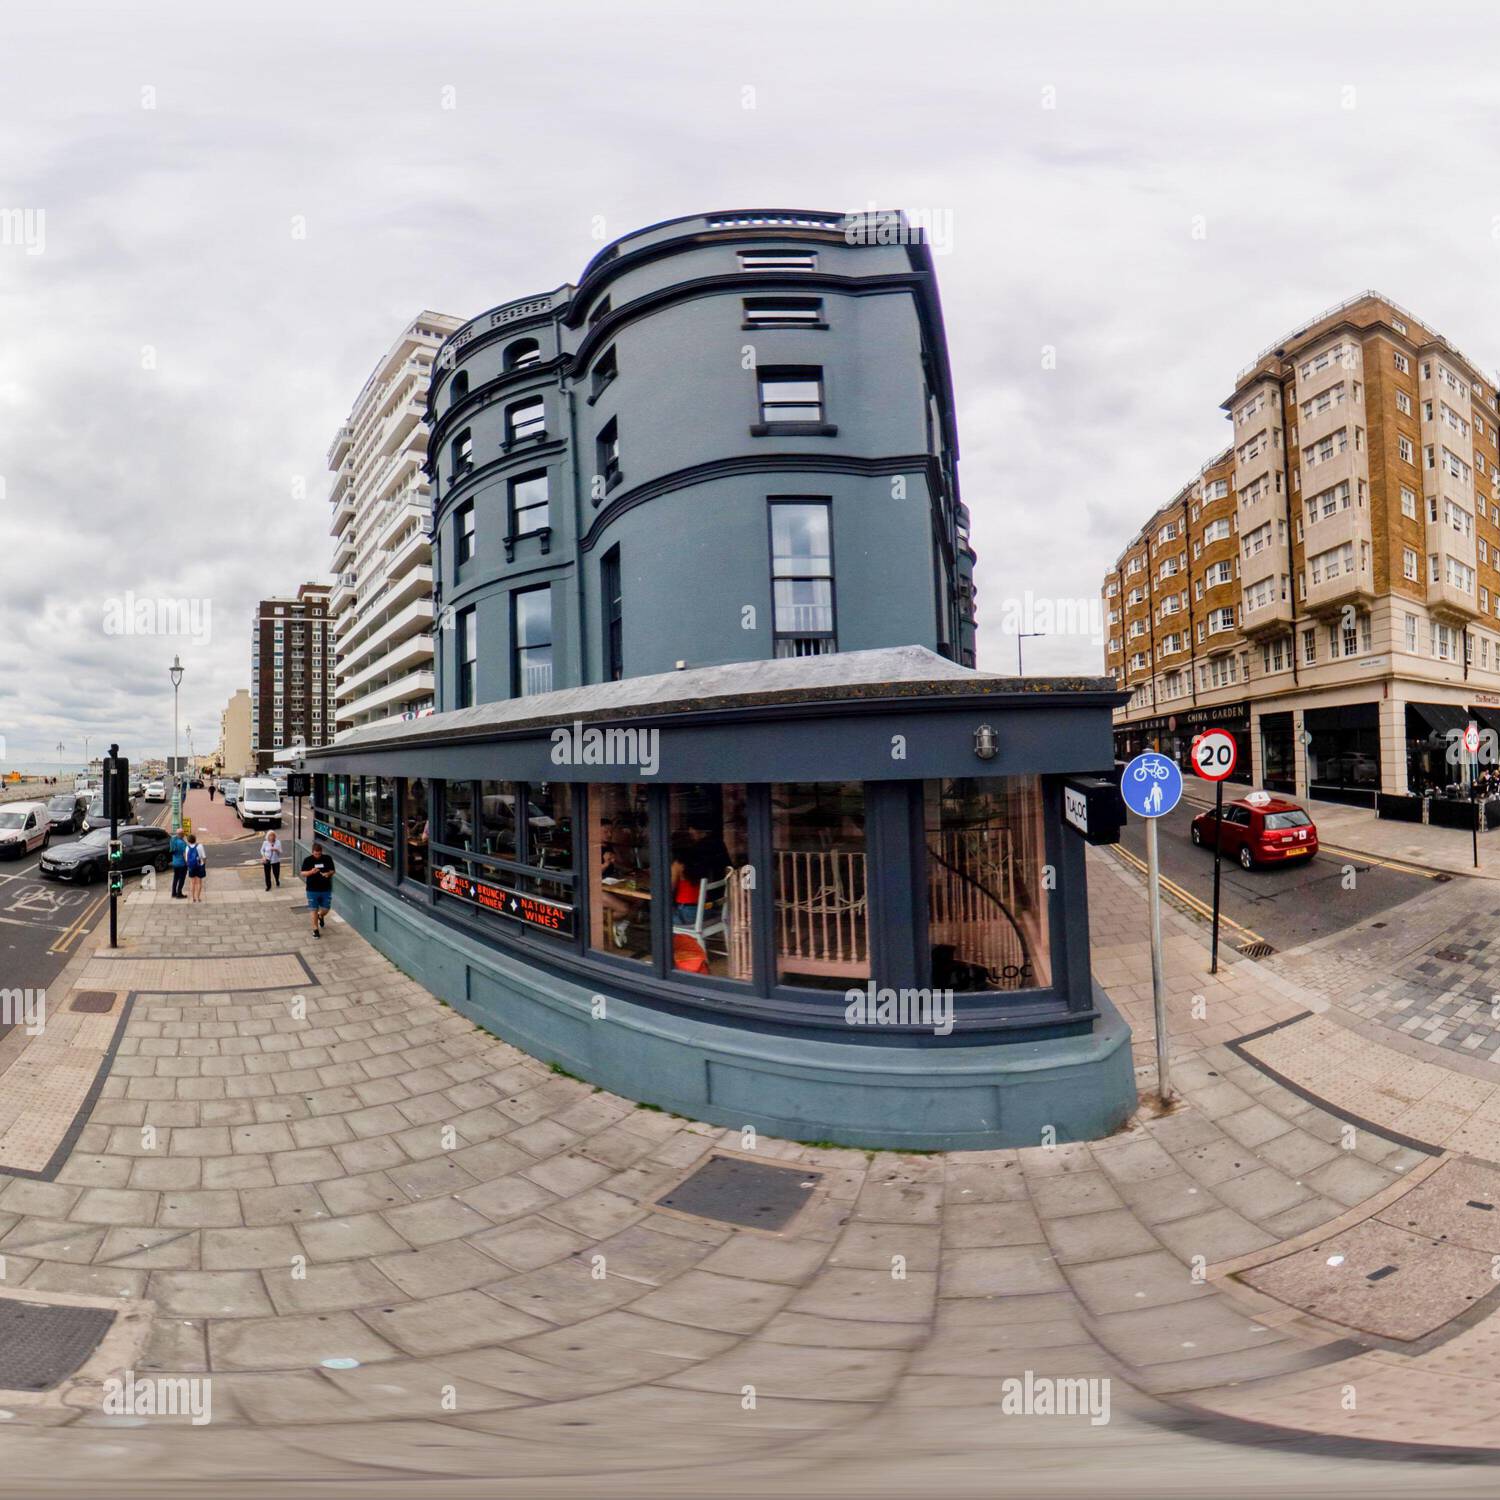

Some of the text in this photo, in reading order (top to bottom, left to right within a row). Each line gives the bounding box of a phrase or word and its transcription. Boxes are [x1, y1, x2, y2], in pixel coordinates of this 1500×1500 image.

[1187, 706, 1244, 723] CHINA GARDEN
[1200, 745, 1231, 767] 20
[333, 829, 356, 849] MEXICAN
[361, 841, 386, 863] CUISINE
[434, 870, 469, 889] COAILS
[477, 883, 506, 902] BRUNCH
[478, 894, 503, 911] DINNER
[521, 898, 565, 920] NATURAL
[525, 909, 559, 929] WINES
